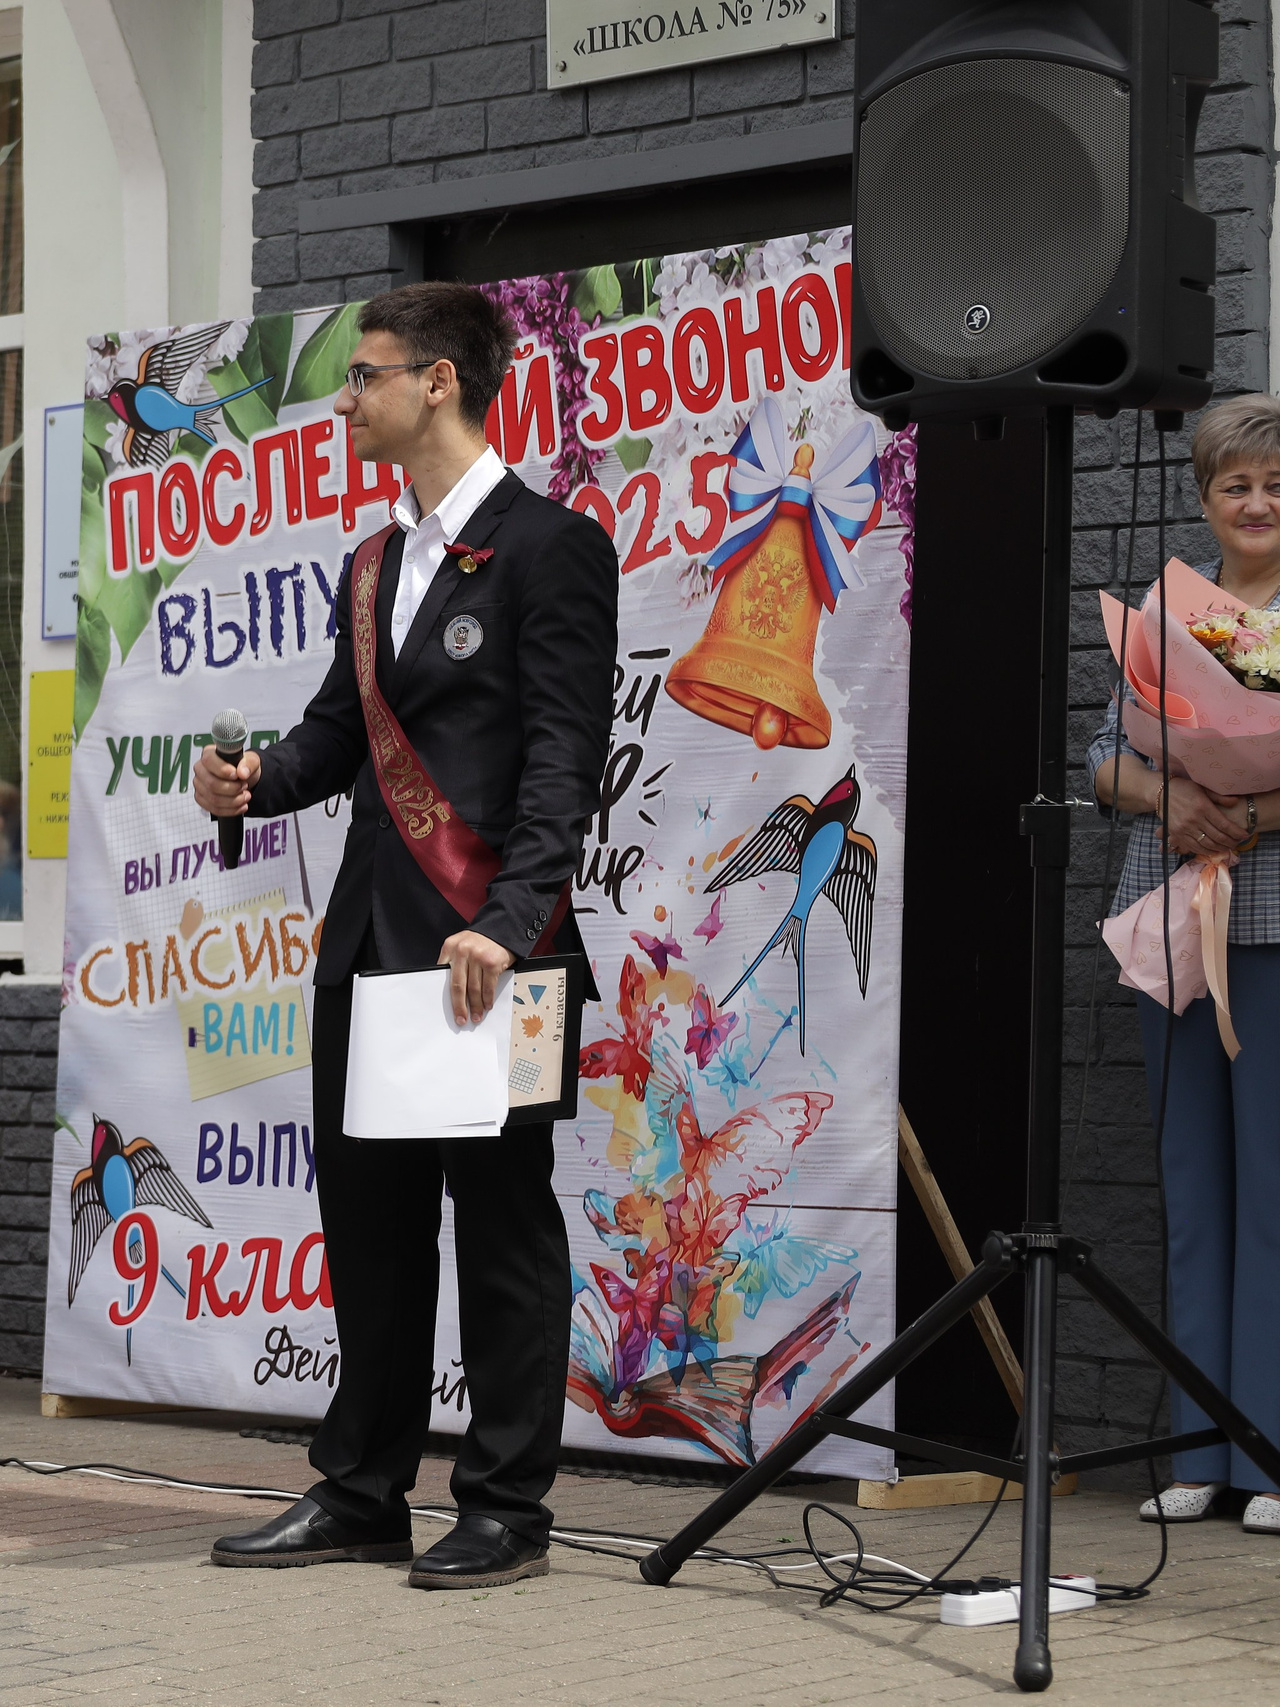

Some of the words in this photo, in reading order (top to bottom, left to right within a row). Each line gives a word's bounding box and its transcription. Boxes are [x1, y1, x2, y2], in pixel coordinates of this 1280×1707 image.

[573, 7, 709, 56] «ШКОЛА
[716, 0, 752, 30] №
[158, 552, 353, 677] ВЫПУ
[37, 746, 73, 757] ОБЩЕО
[51, 792, 69, 803] РЕЖ
[380, 751, 451, 839] 2025
[125, 853, 162, 895] ВЫ
[80, 912, 325, 1007] СПАСИБ
[203, 1002, 296, 1057] ВАМ!
[556, 976, 565, 1029] классы
[552, 1034, 563, 1042] 9
[197, 1121, 316, 1193] ВЫПУ
[109, 1212, 159, 1326] 9
[186, 1232, 334, 1320] кла
